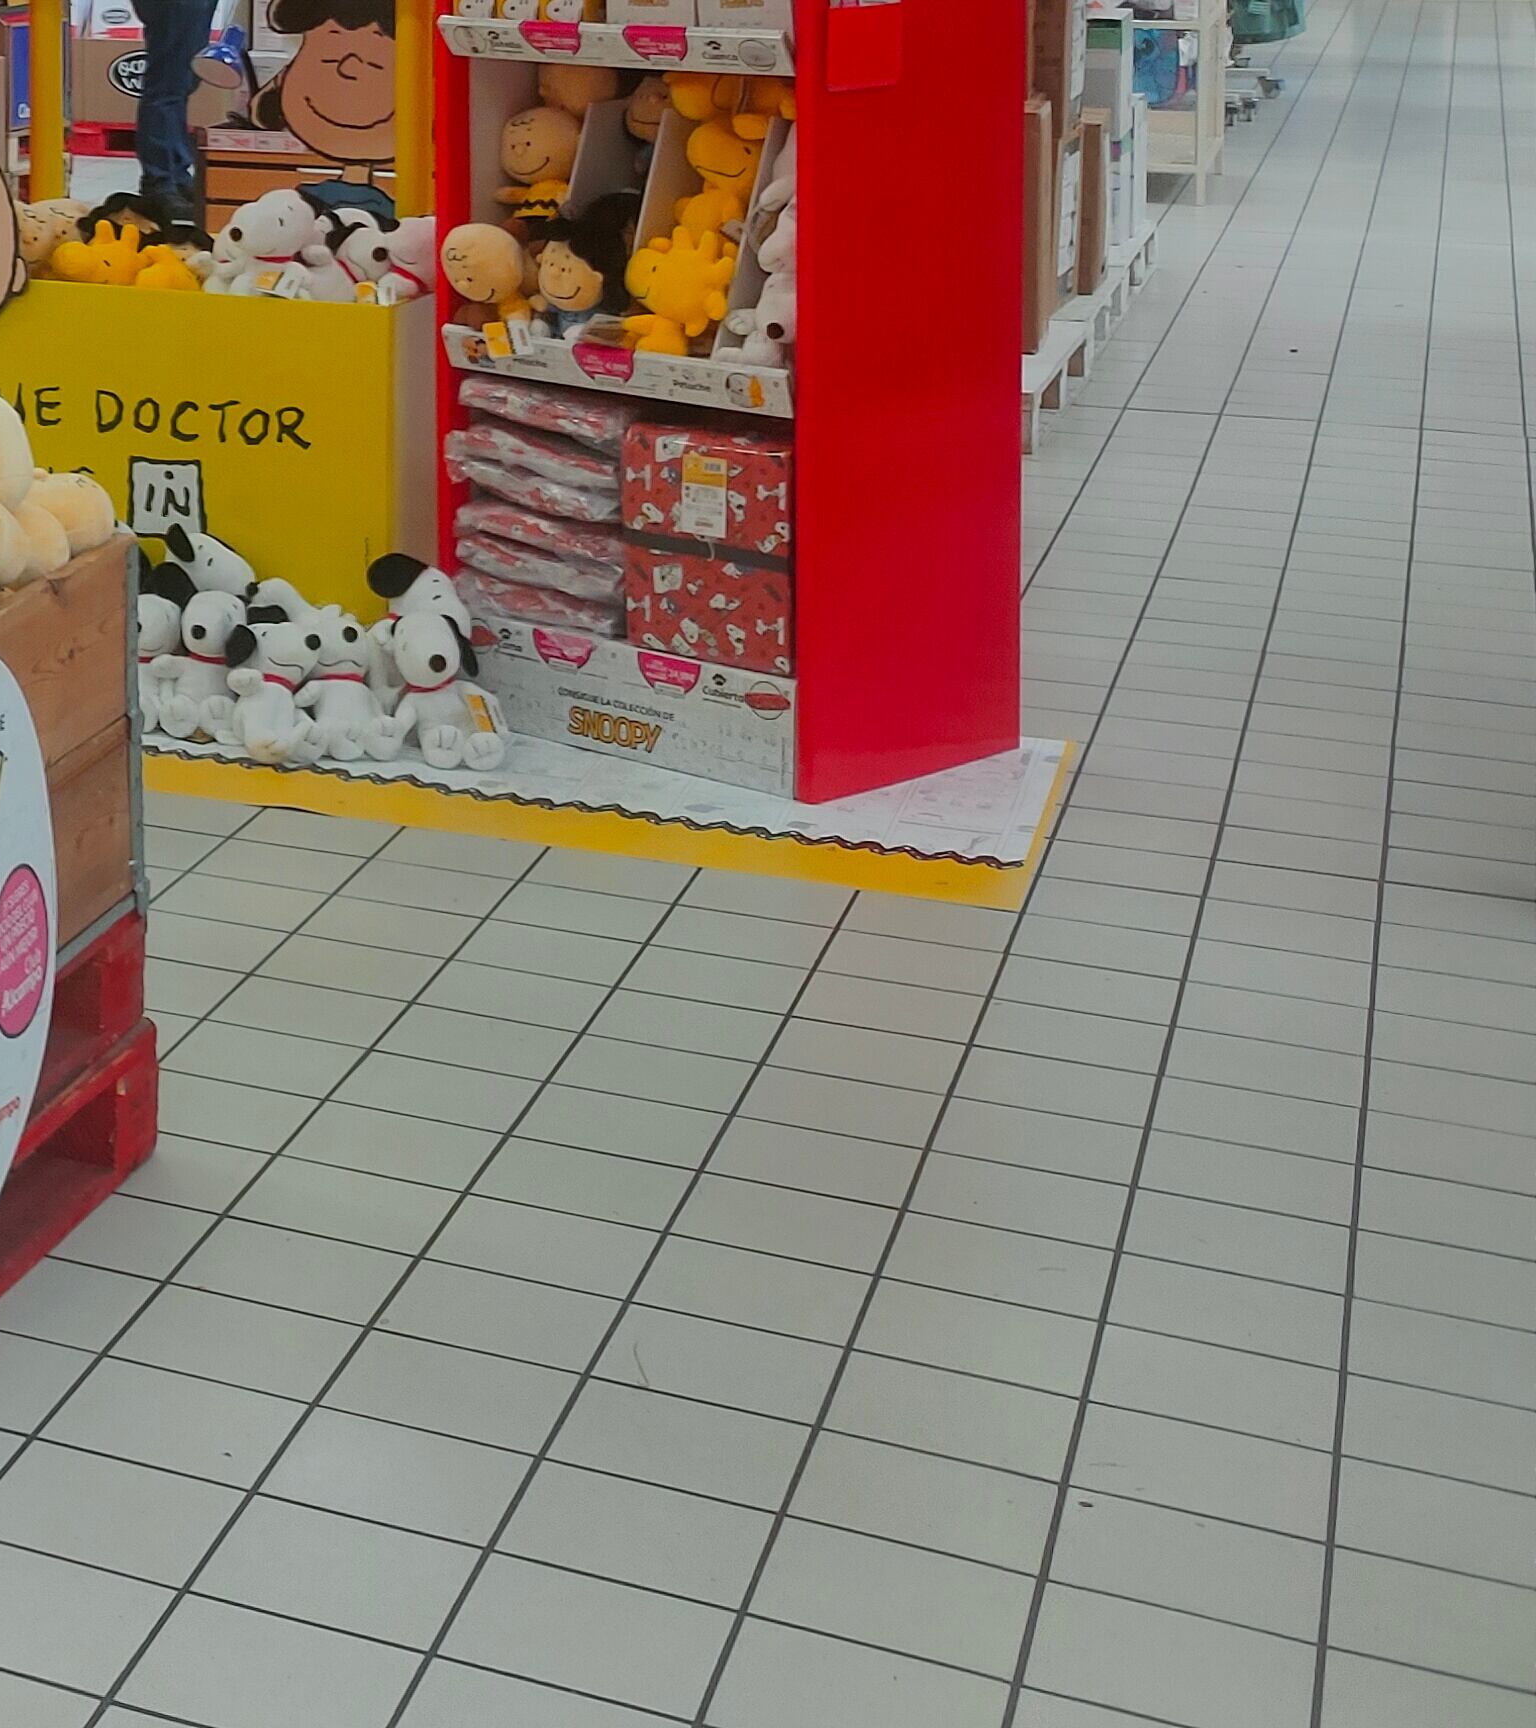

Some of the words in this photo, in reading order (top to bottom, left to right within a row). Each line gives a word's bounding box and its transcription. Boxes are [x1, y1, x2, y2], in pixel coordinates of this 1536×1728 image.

[96, 389, 311, 450] DOCTOR
[145, 482, 190, 518] IN
[569, 705, 662, 754] SNOOPY
